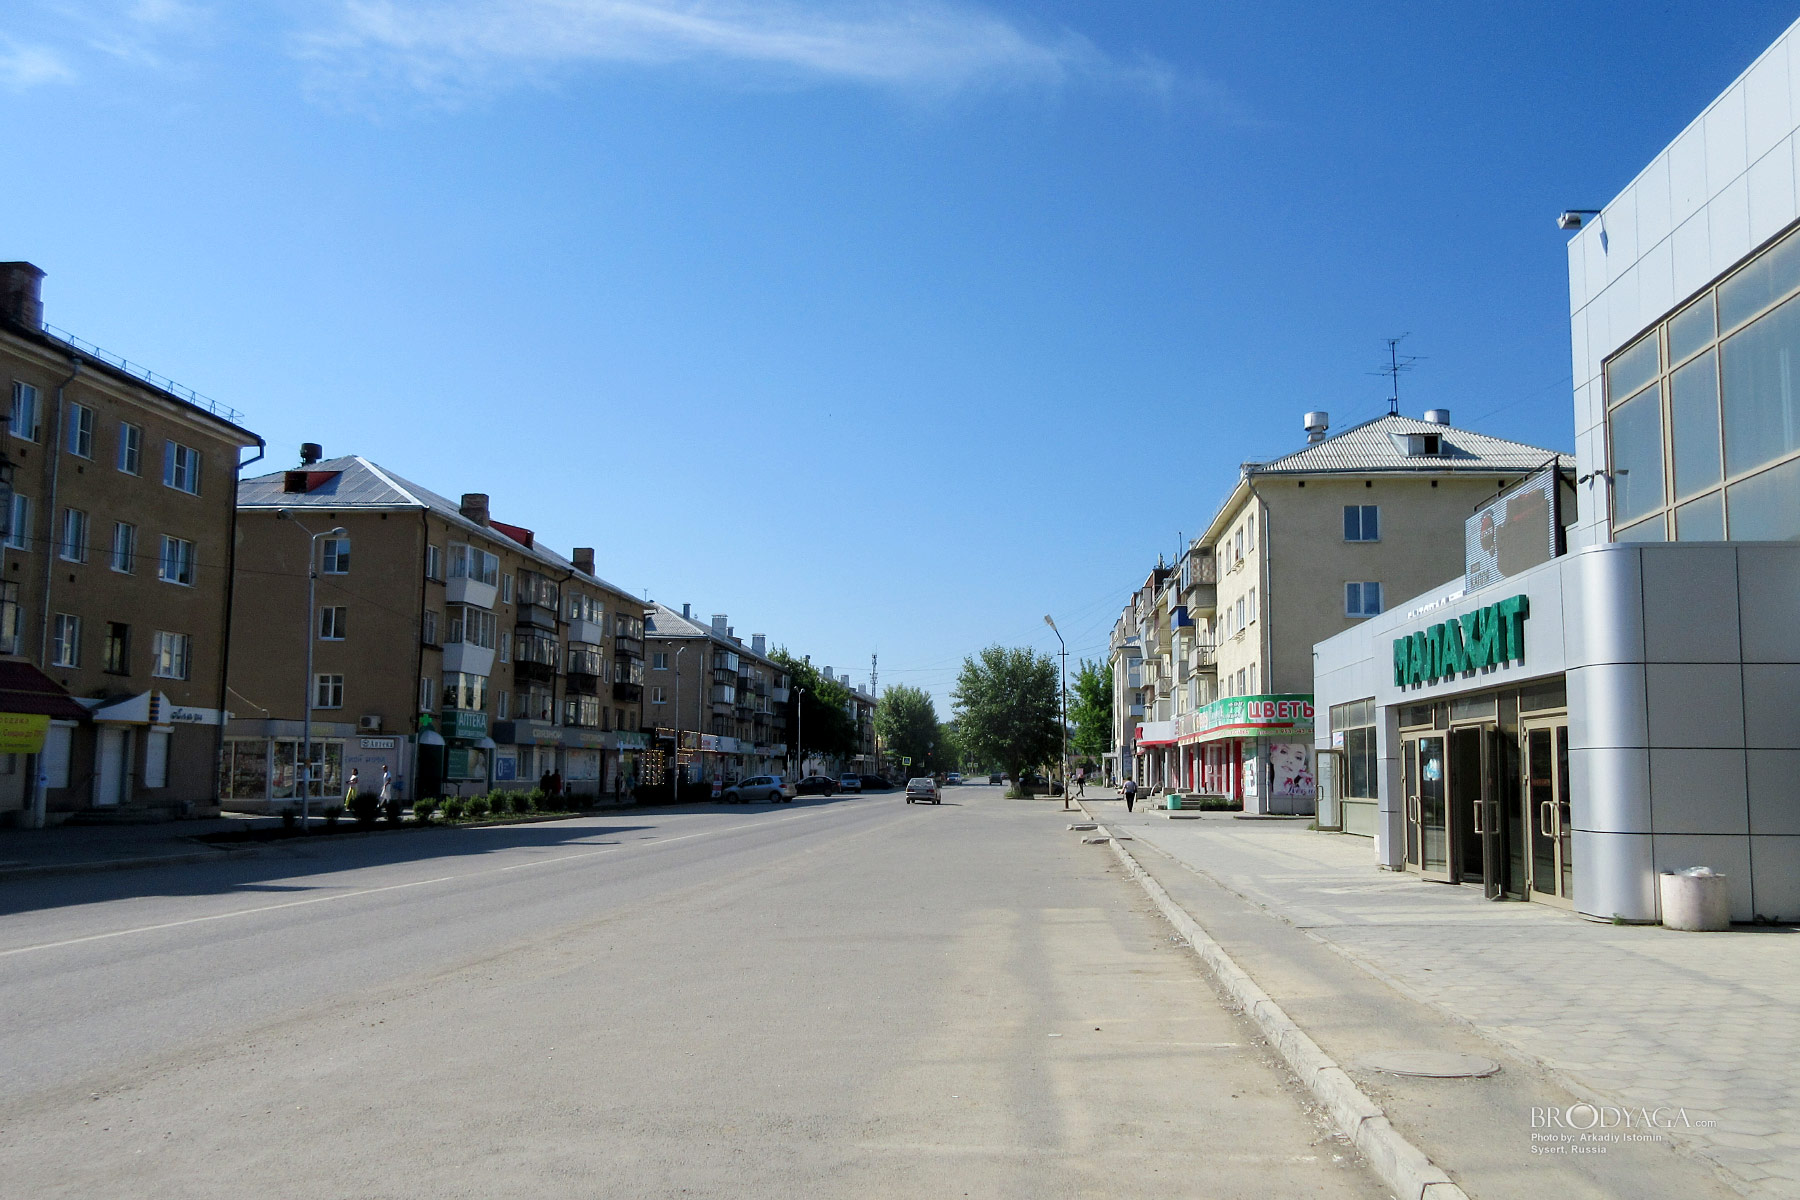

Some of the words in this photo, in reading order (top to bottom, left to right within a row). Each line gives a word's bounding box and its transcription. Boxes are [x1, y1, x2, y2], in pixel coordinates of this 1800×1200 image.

[1393, 594, 1529, 687] МАЛАХИТ
[458, 712, 487, 728] АПТЕКА
[371, 740, 393, 748] Аптека
